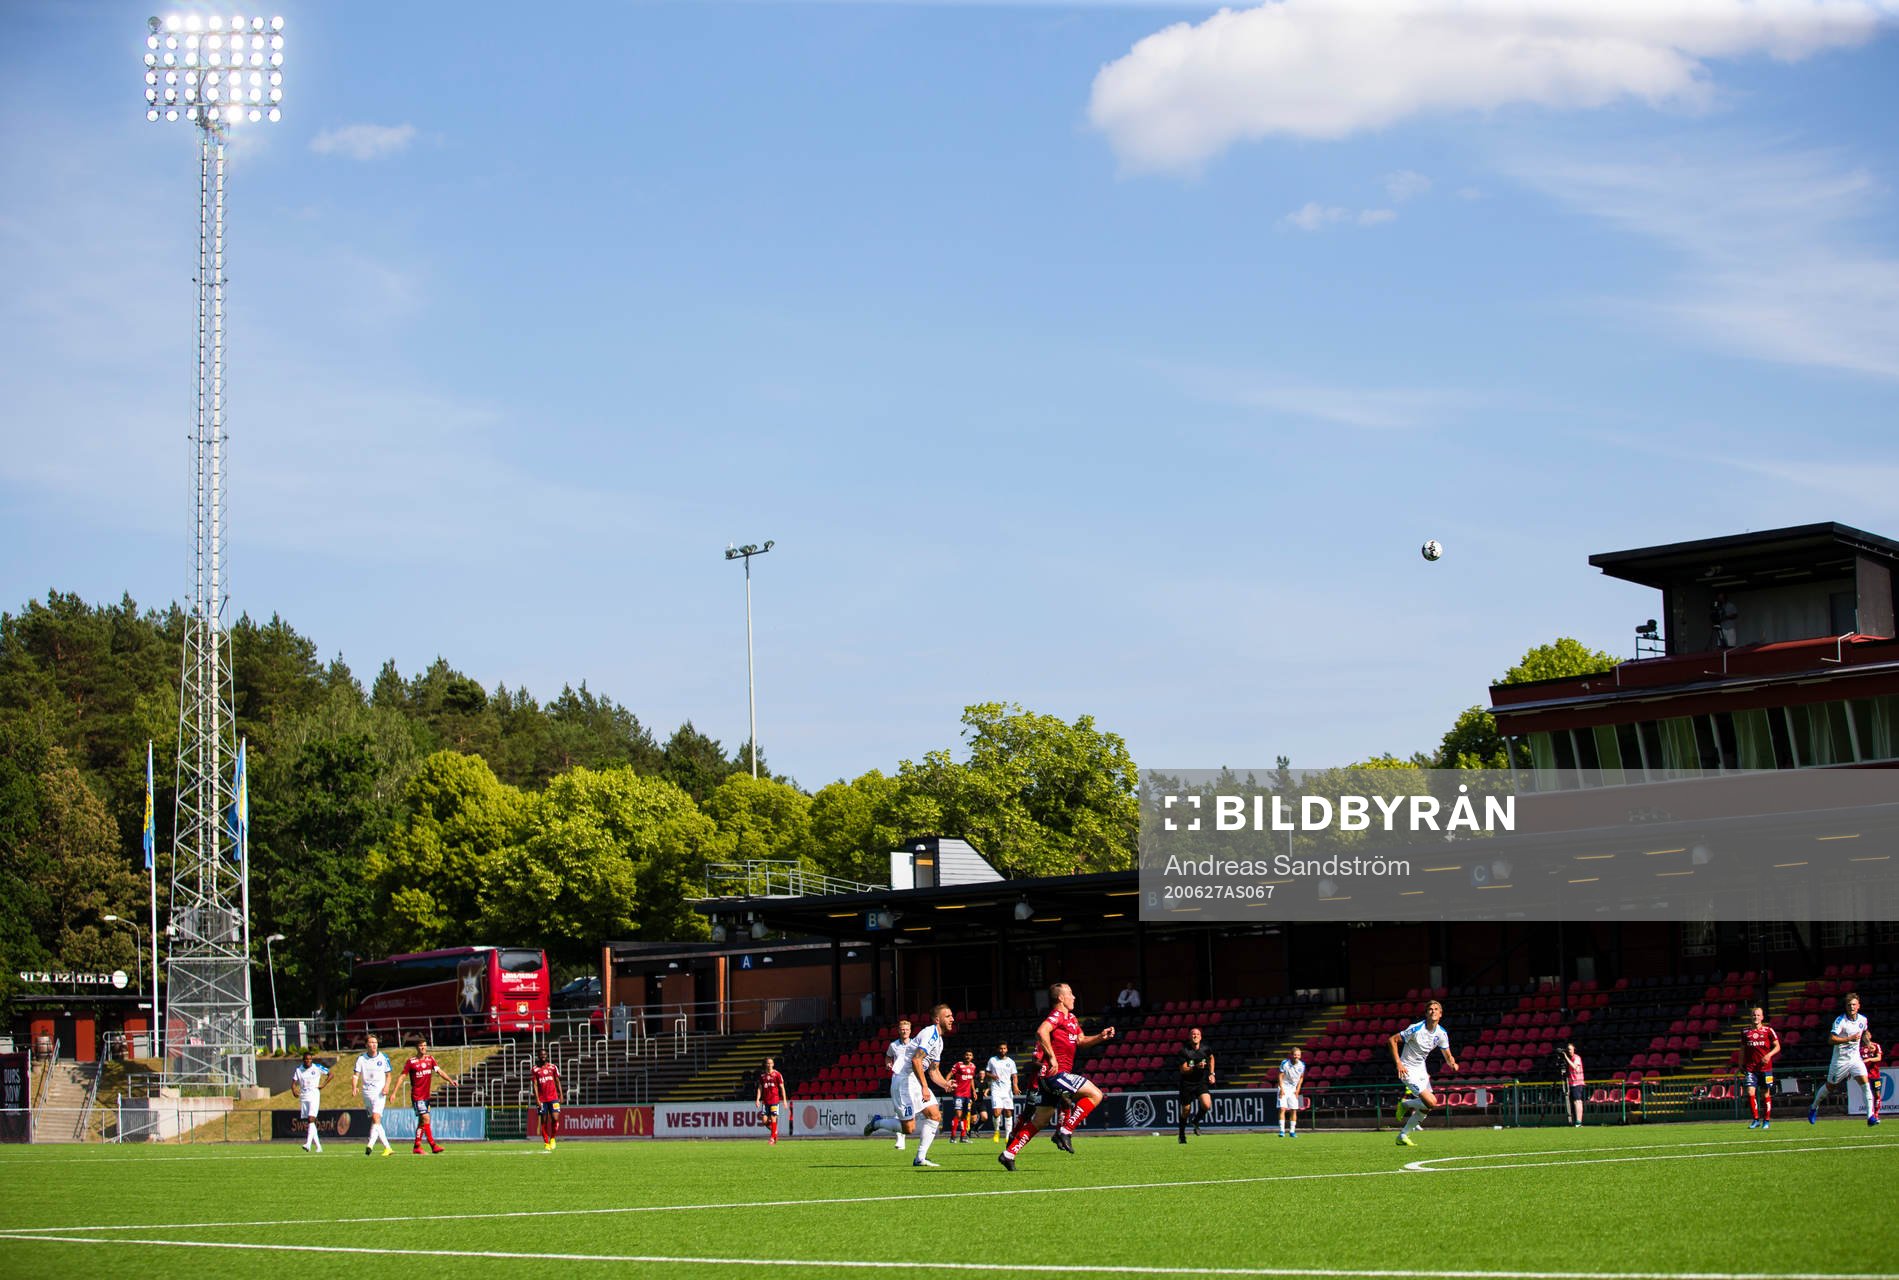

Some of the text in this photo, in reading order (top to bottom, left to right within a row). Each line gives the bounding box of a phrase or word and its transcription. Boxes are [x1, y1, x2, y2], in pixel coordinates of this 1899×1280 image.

[868, 913, 877, 927] B
[742, 955, 751, 969] A
[291, 1117, 335, 1132] Swebank
[564, 1114, 615, 1129] i'm lovin' it
[666, 1111, 728, 1128] WESTIN
[819, 1108, 856, 1131] Hjerta
